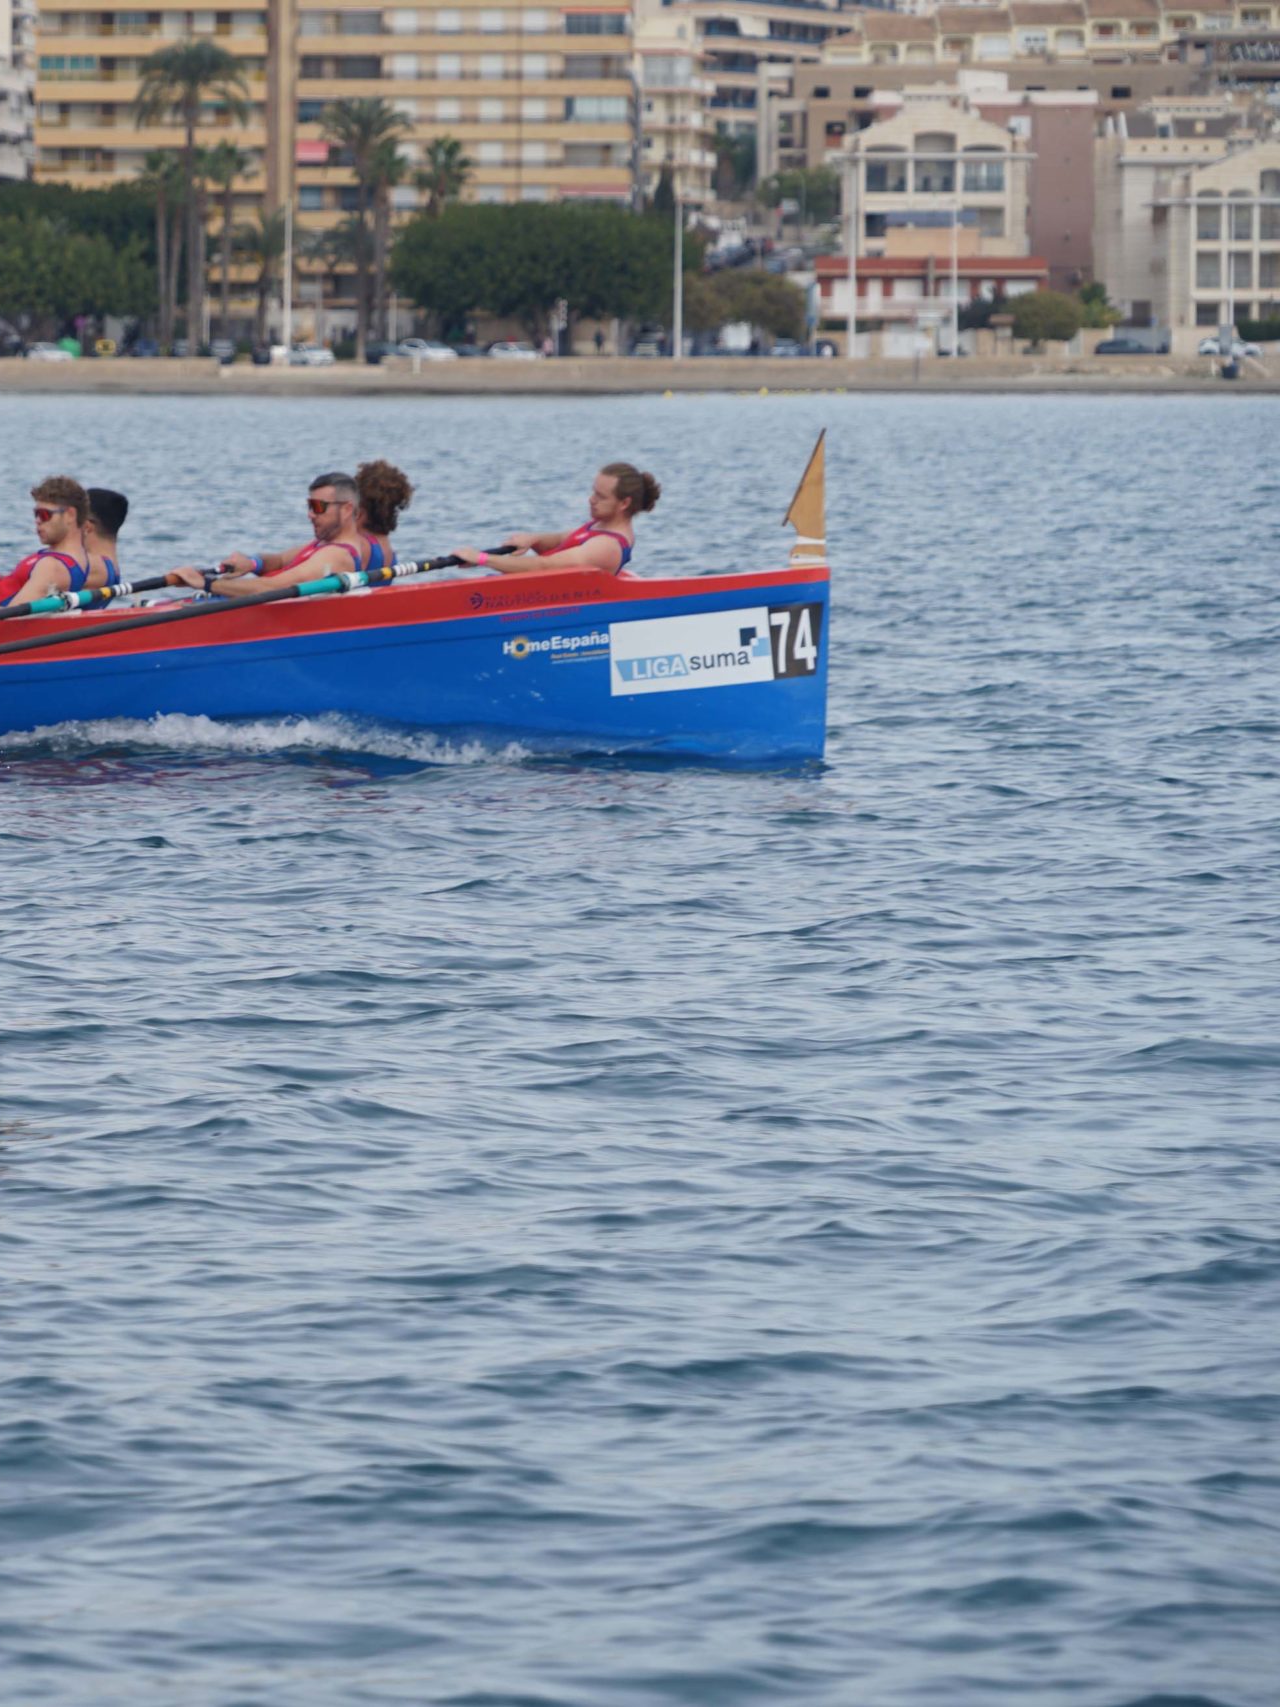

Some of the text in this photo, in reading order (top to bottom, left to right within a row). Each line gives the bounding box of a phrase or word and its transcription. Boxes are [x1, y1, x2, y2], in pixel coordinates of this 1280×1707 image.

[632, 657, 688, 679] LIGA
[690, 650, 751, 670] suma
[770, 608, 818, 674] 74
